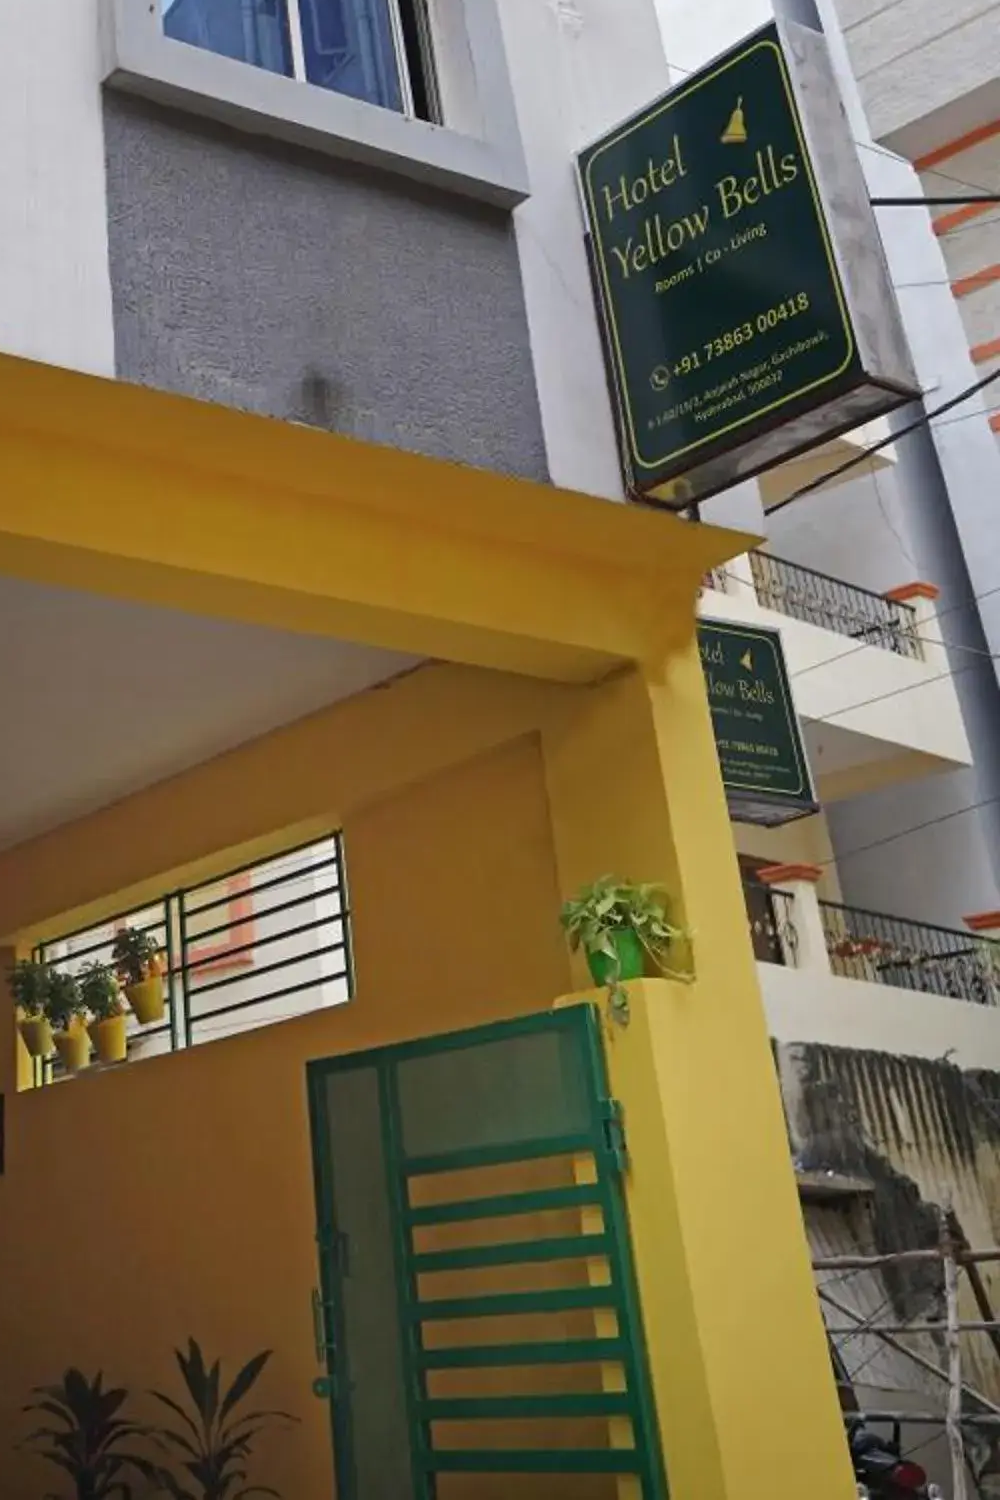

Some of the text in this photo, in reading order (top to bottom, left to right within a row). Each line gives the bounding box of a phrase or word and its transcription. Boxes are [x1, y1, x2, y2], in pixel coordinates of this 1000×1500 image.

[602, 133, 688, 223] Hotel
[611, 144, 798, 278] Yellow Bells
[655, 265, 695, 292] Rooms
[705, 249, 721, 264] Co
[730, 222, 767, 250] Living
[673, 291, 809, 376] +91 73863 00418
[736, 679, 775, 705] Bells
